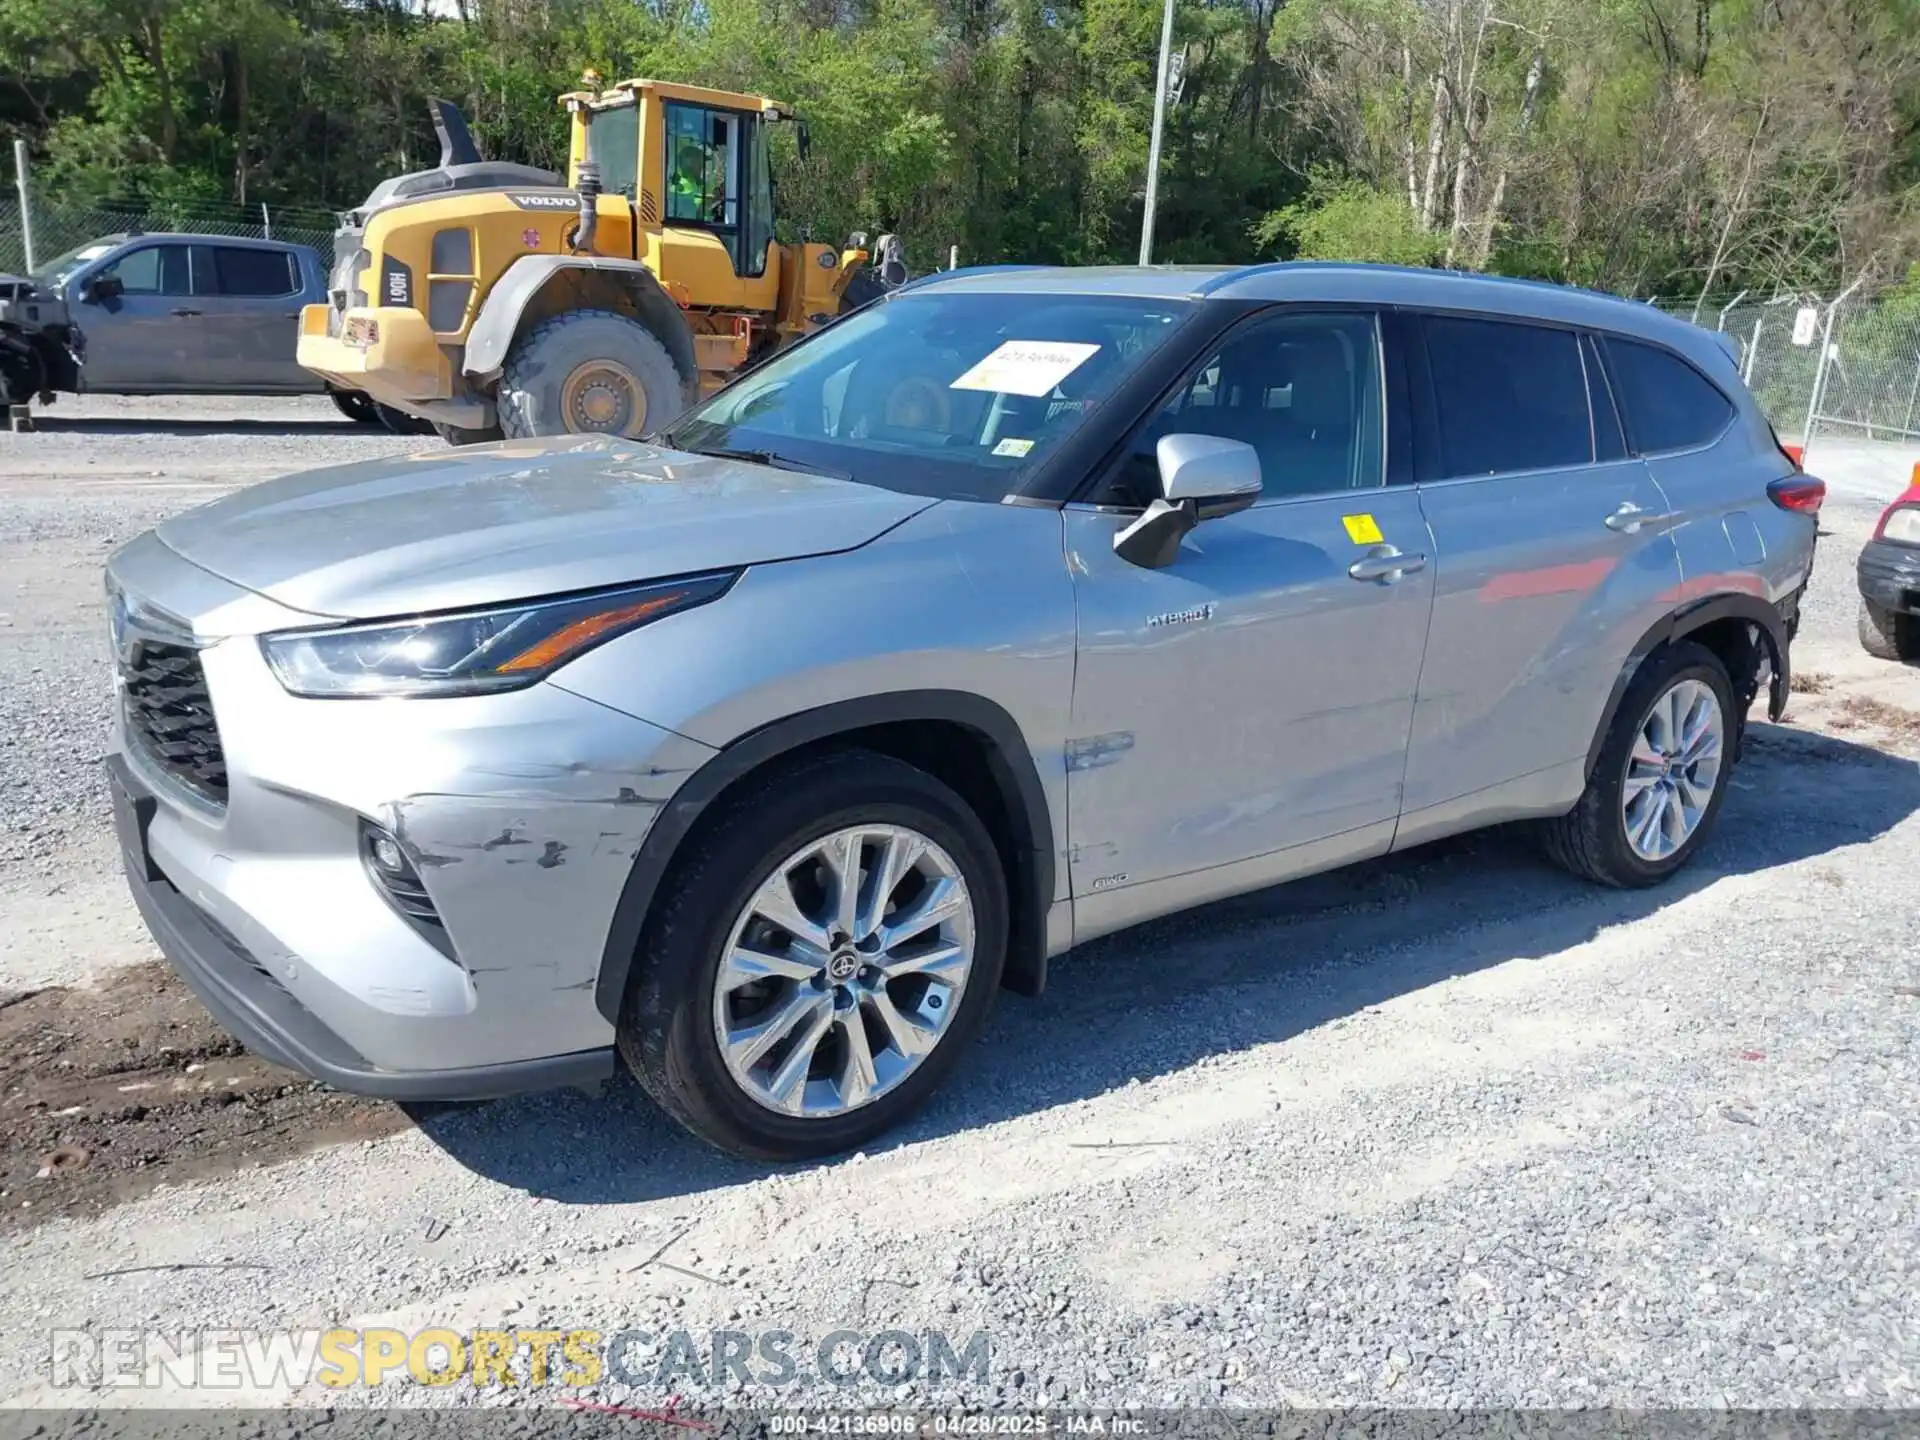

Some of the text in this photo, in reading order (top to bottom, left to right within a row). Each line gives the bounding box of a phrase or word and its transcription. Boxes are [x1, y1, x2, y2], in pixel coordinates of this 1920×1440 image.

[515, 195, 577, 206] VOLVO
[389, 272, 408, 302] L90H
[1145, 610, 1204, 627] HYBRID
